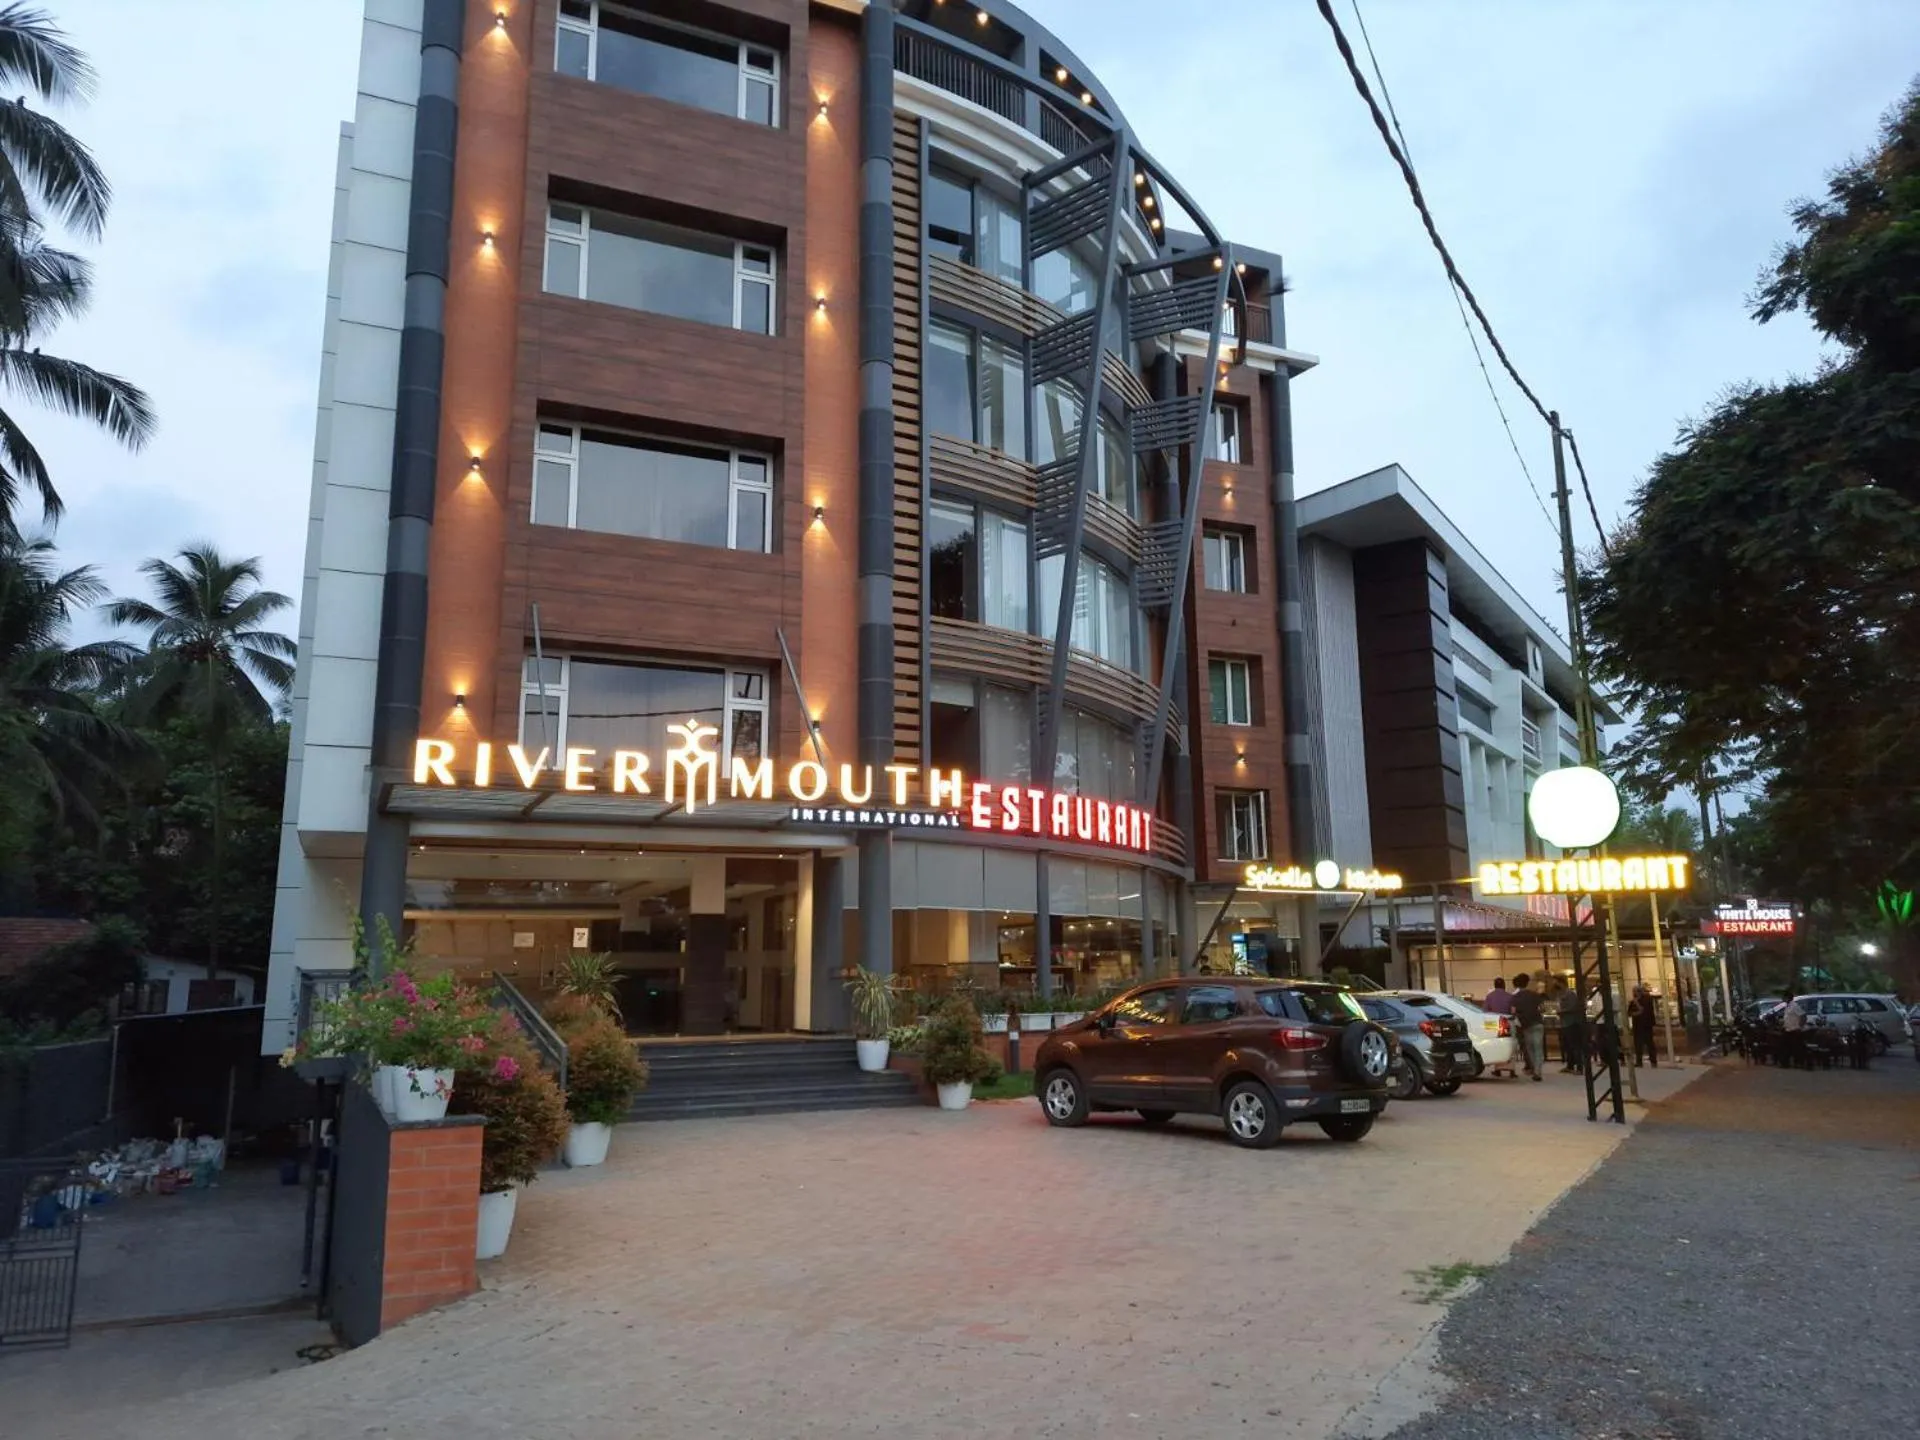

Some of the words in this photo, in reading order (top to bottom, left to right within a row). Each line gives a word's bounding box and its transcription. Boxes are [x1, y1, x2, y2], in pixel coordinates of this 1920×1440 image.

[413, 738, 652, 795] RIVER
[730, 757, 963, 808] MOUTH
[790, 806, 961, 829] INTERNATIONAL
[971, 782, 1152, 851] ESTAURANT
[1478, 855, 1690, 895] RESTAURANT
[1753, 909, 1791, 920] HOUSE
